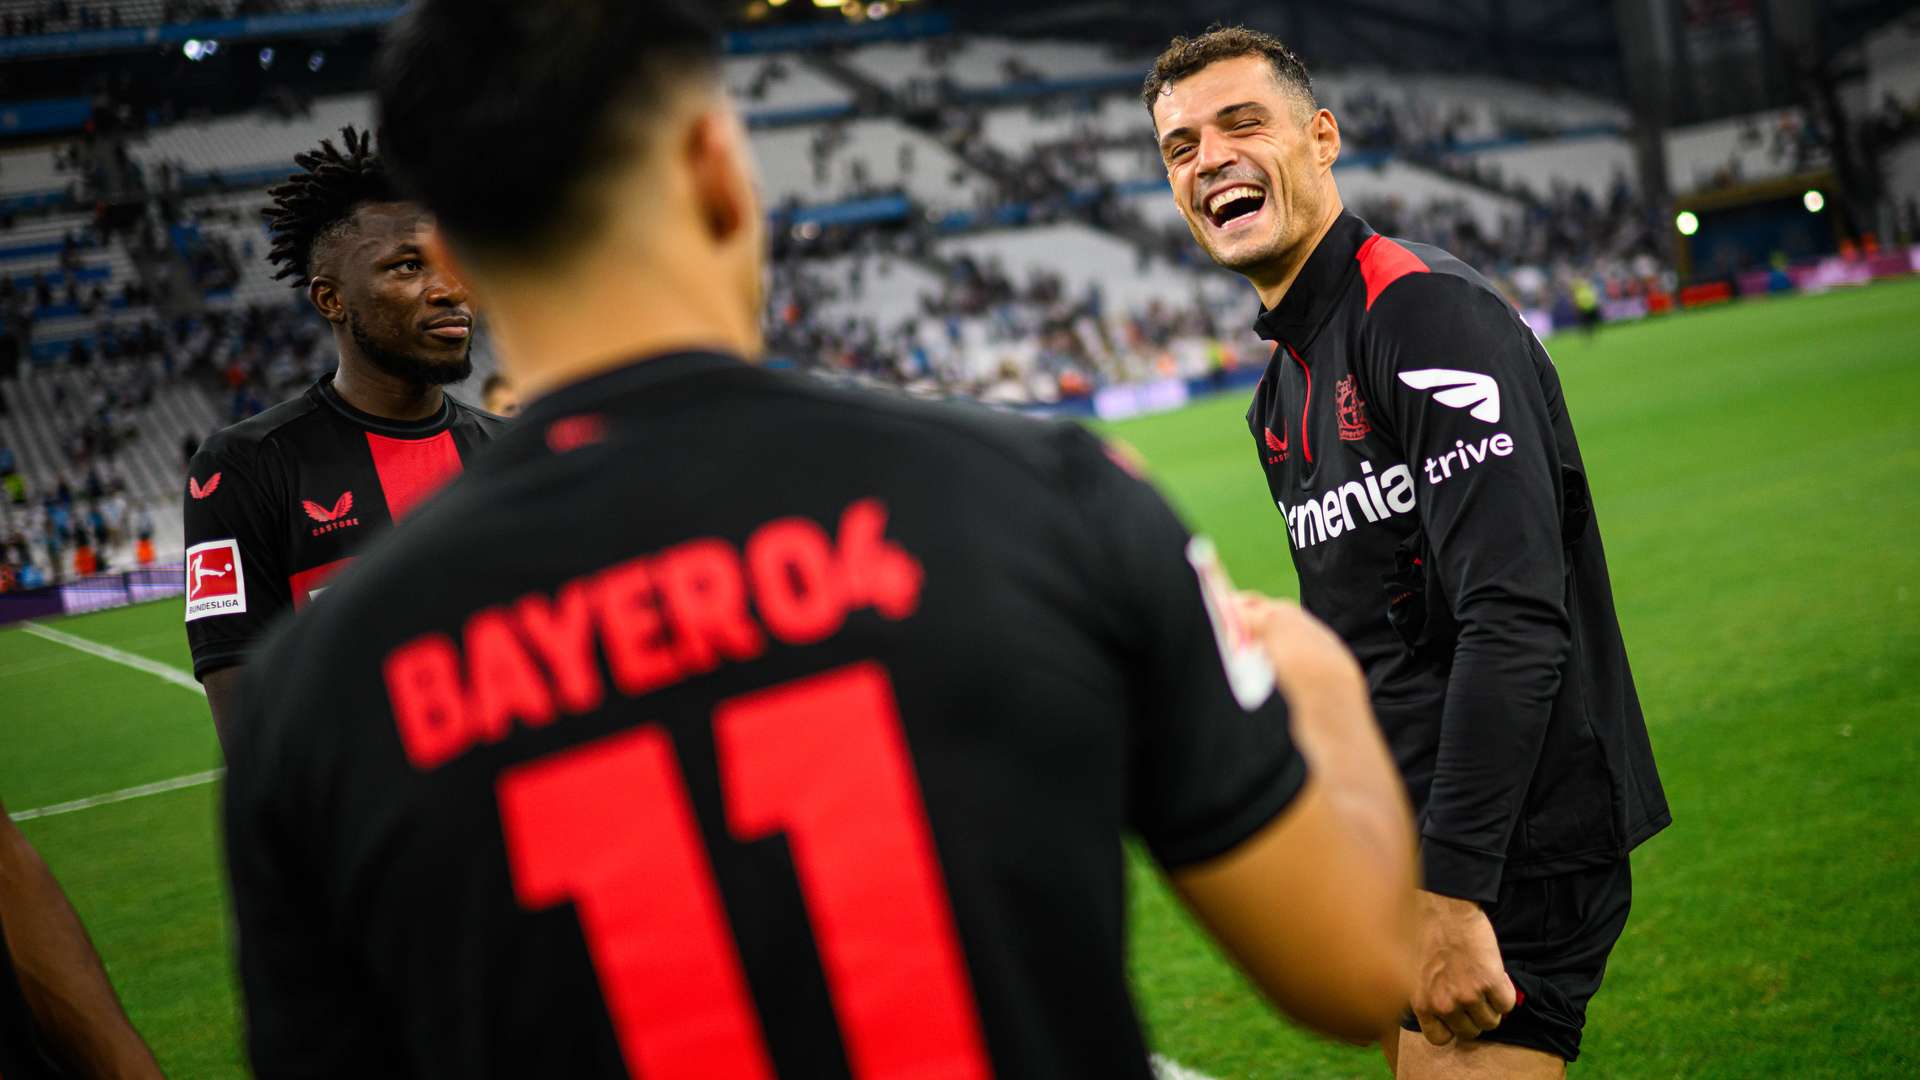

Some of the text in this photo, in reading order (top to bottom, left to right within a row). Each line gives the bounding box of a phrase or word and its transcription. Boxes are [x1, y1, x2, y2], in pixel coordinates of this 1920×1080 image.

[1424, 433, 1514, 484] trive
[312, 518, 359, 537] CASTORE
[189, 599, 239, 614] BUNDESLIGA
[496, 658, 996, 1080] 11
